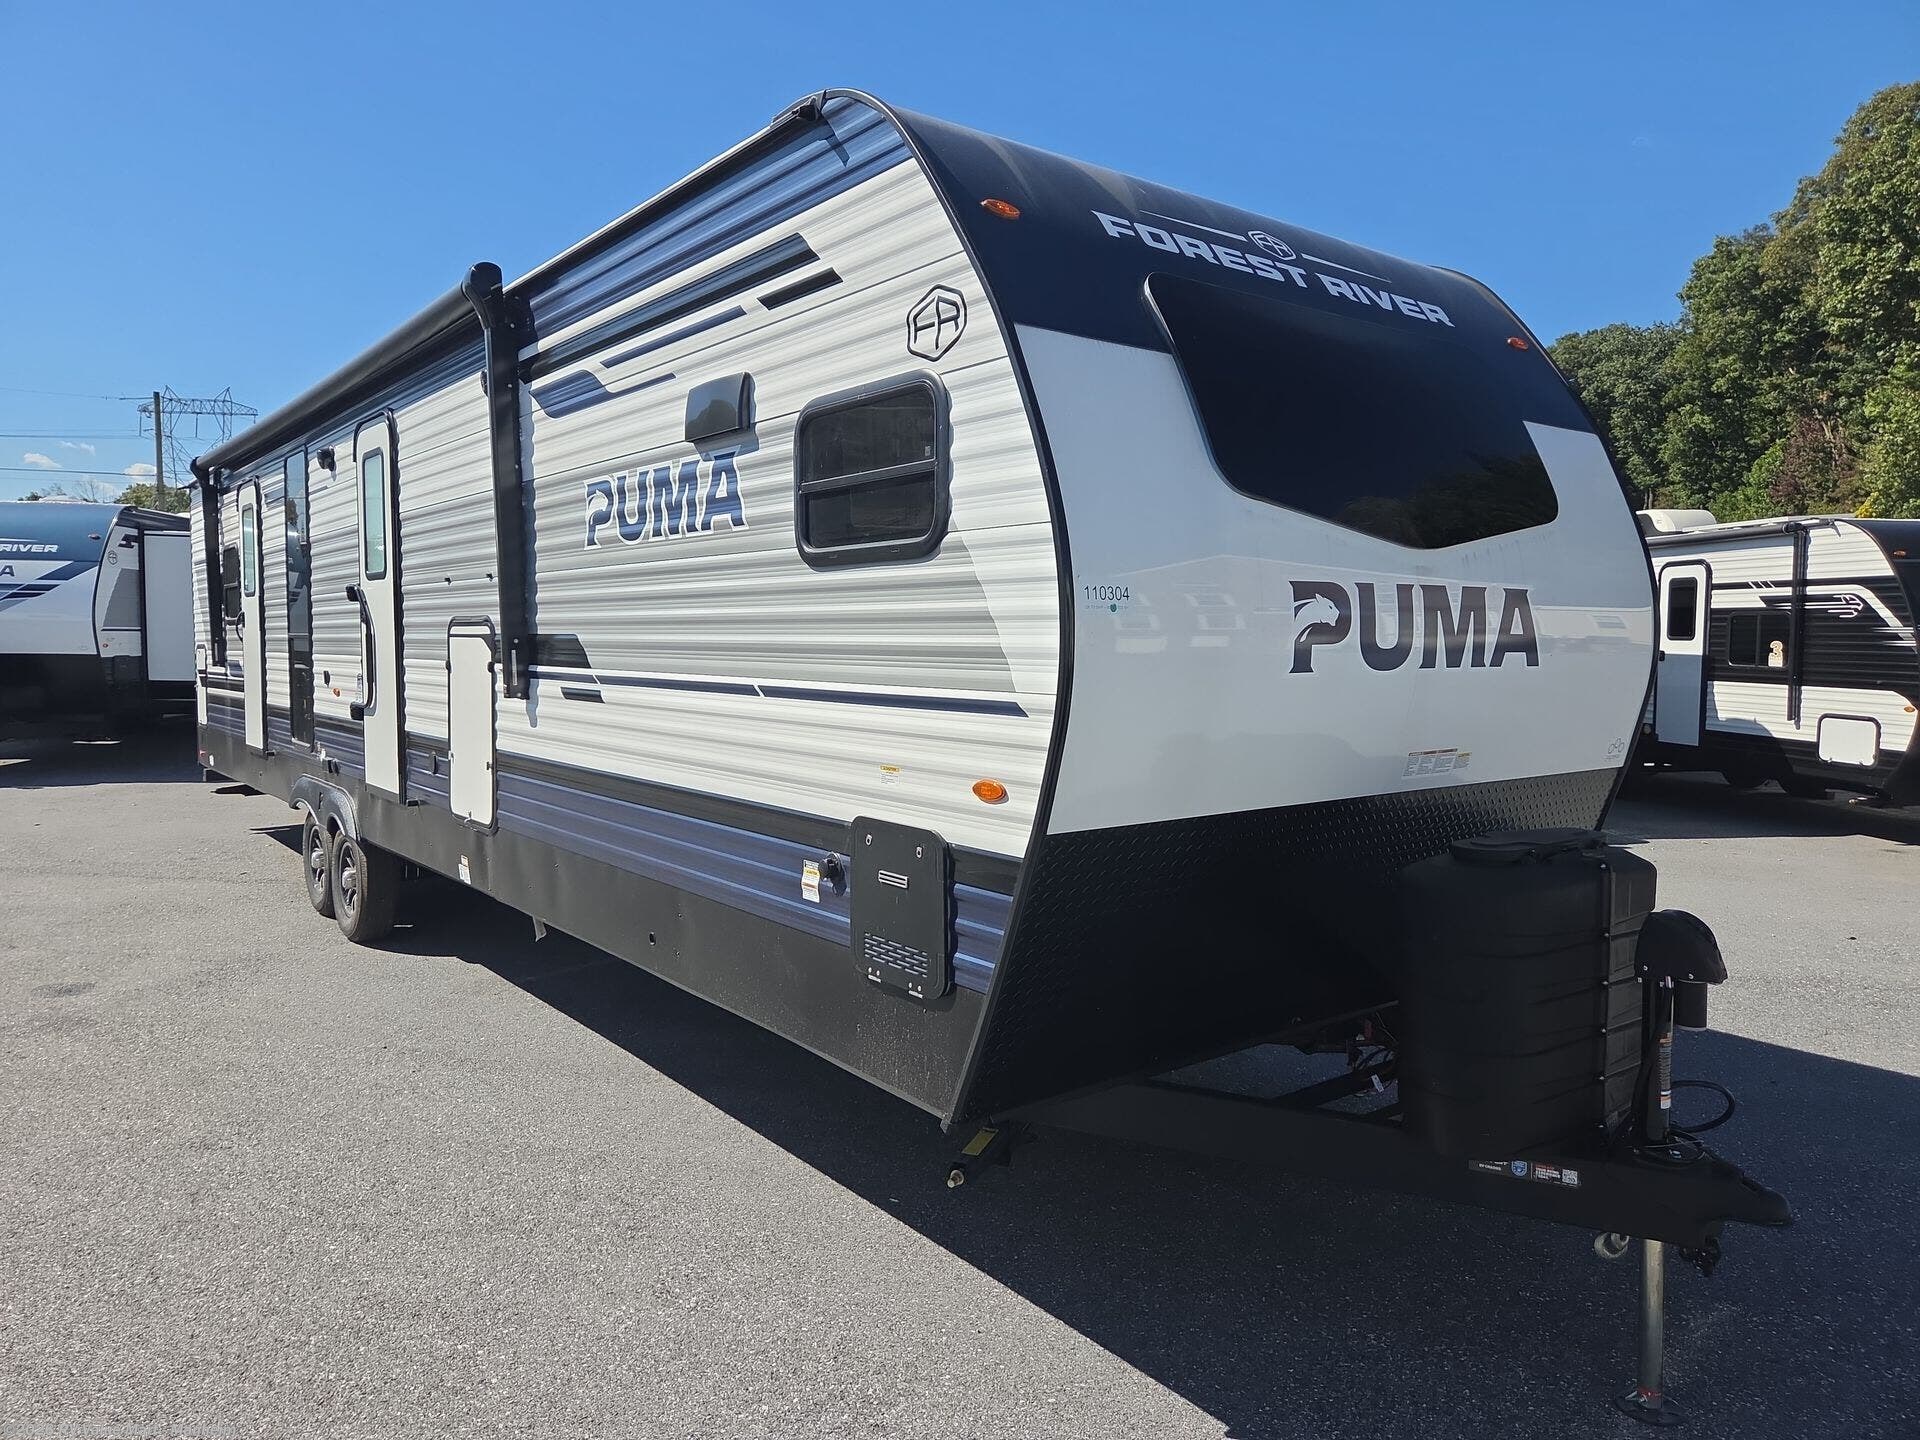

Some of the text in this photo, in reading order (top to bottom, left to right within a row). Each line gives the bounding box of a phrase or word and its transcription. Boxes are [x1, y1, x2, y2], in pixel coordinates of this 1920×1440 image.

[1091, 210, 1455, 327] FOREST RIVER
[583, 444, 749, 550] PUMA
[0, 543, 59, 553] RIVER
[1084, 585, 1130, 601] 110304
[1289, 580, 1540, 673] PUMA
